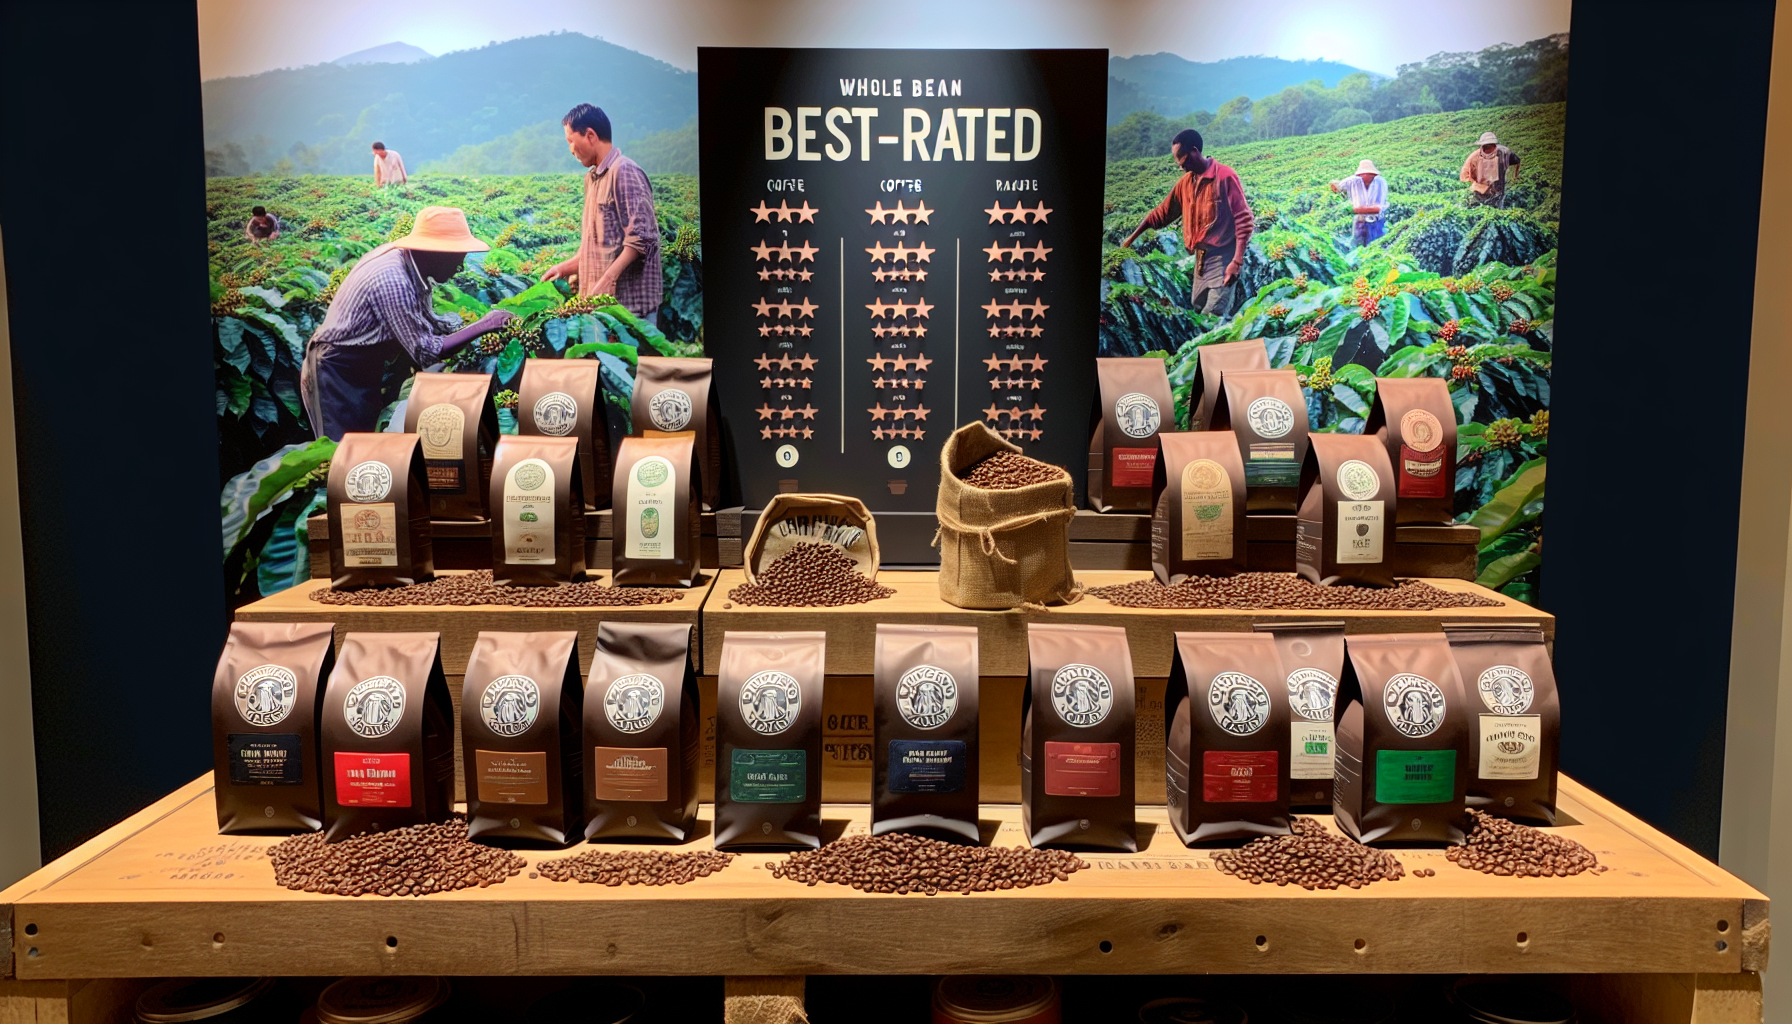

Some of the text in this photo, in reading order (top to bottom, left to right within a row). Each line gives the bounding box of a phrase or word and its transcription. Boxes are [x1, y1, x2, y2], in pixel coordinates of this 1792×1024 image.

[840, 78, 962, 97] WHOLE BEAN
[764, 106, 1042, 162] BEST-RATED
